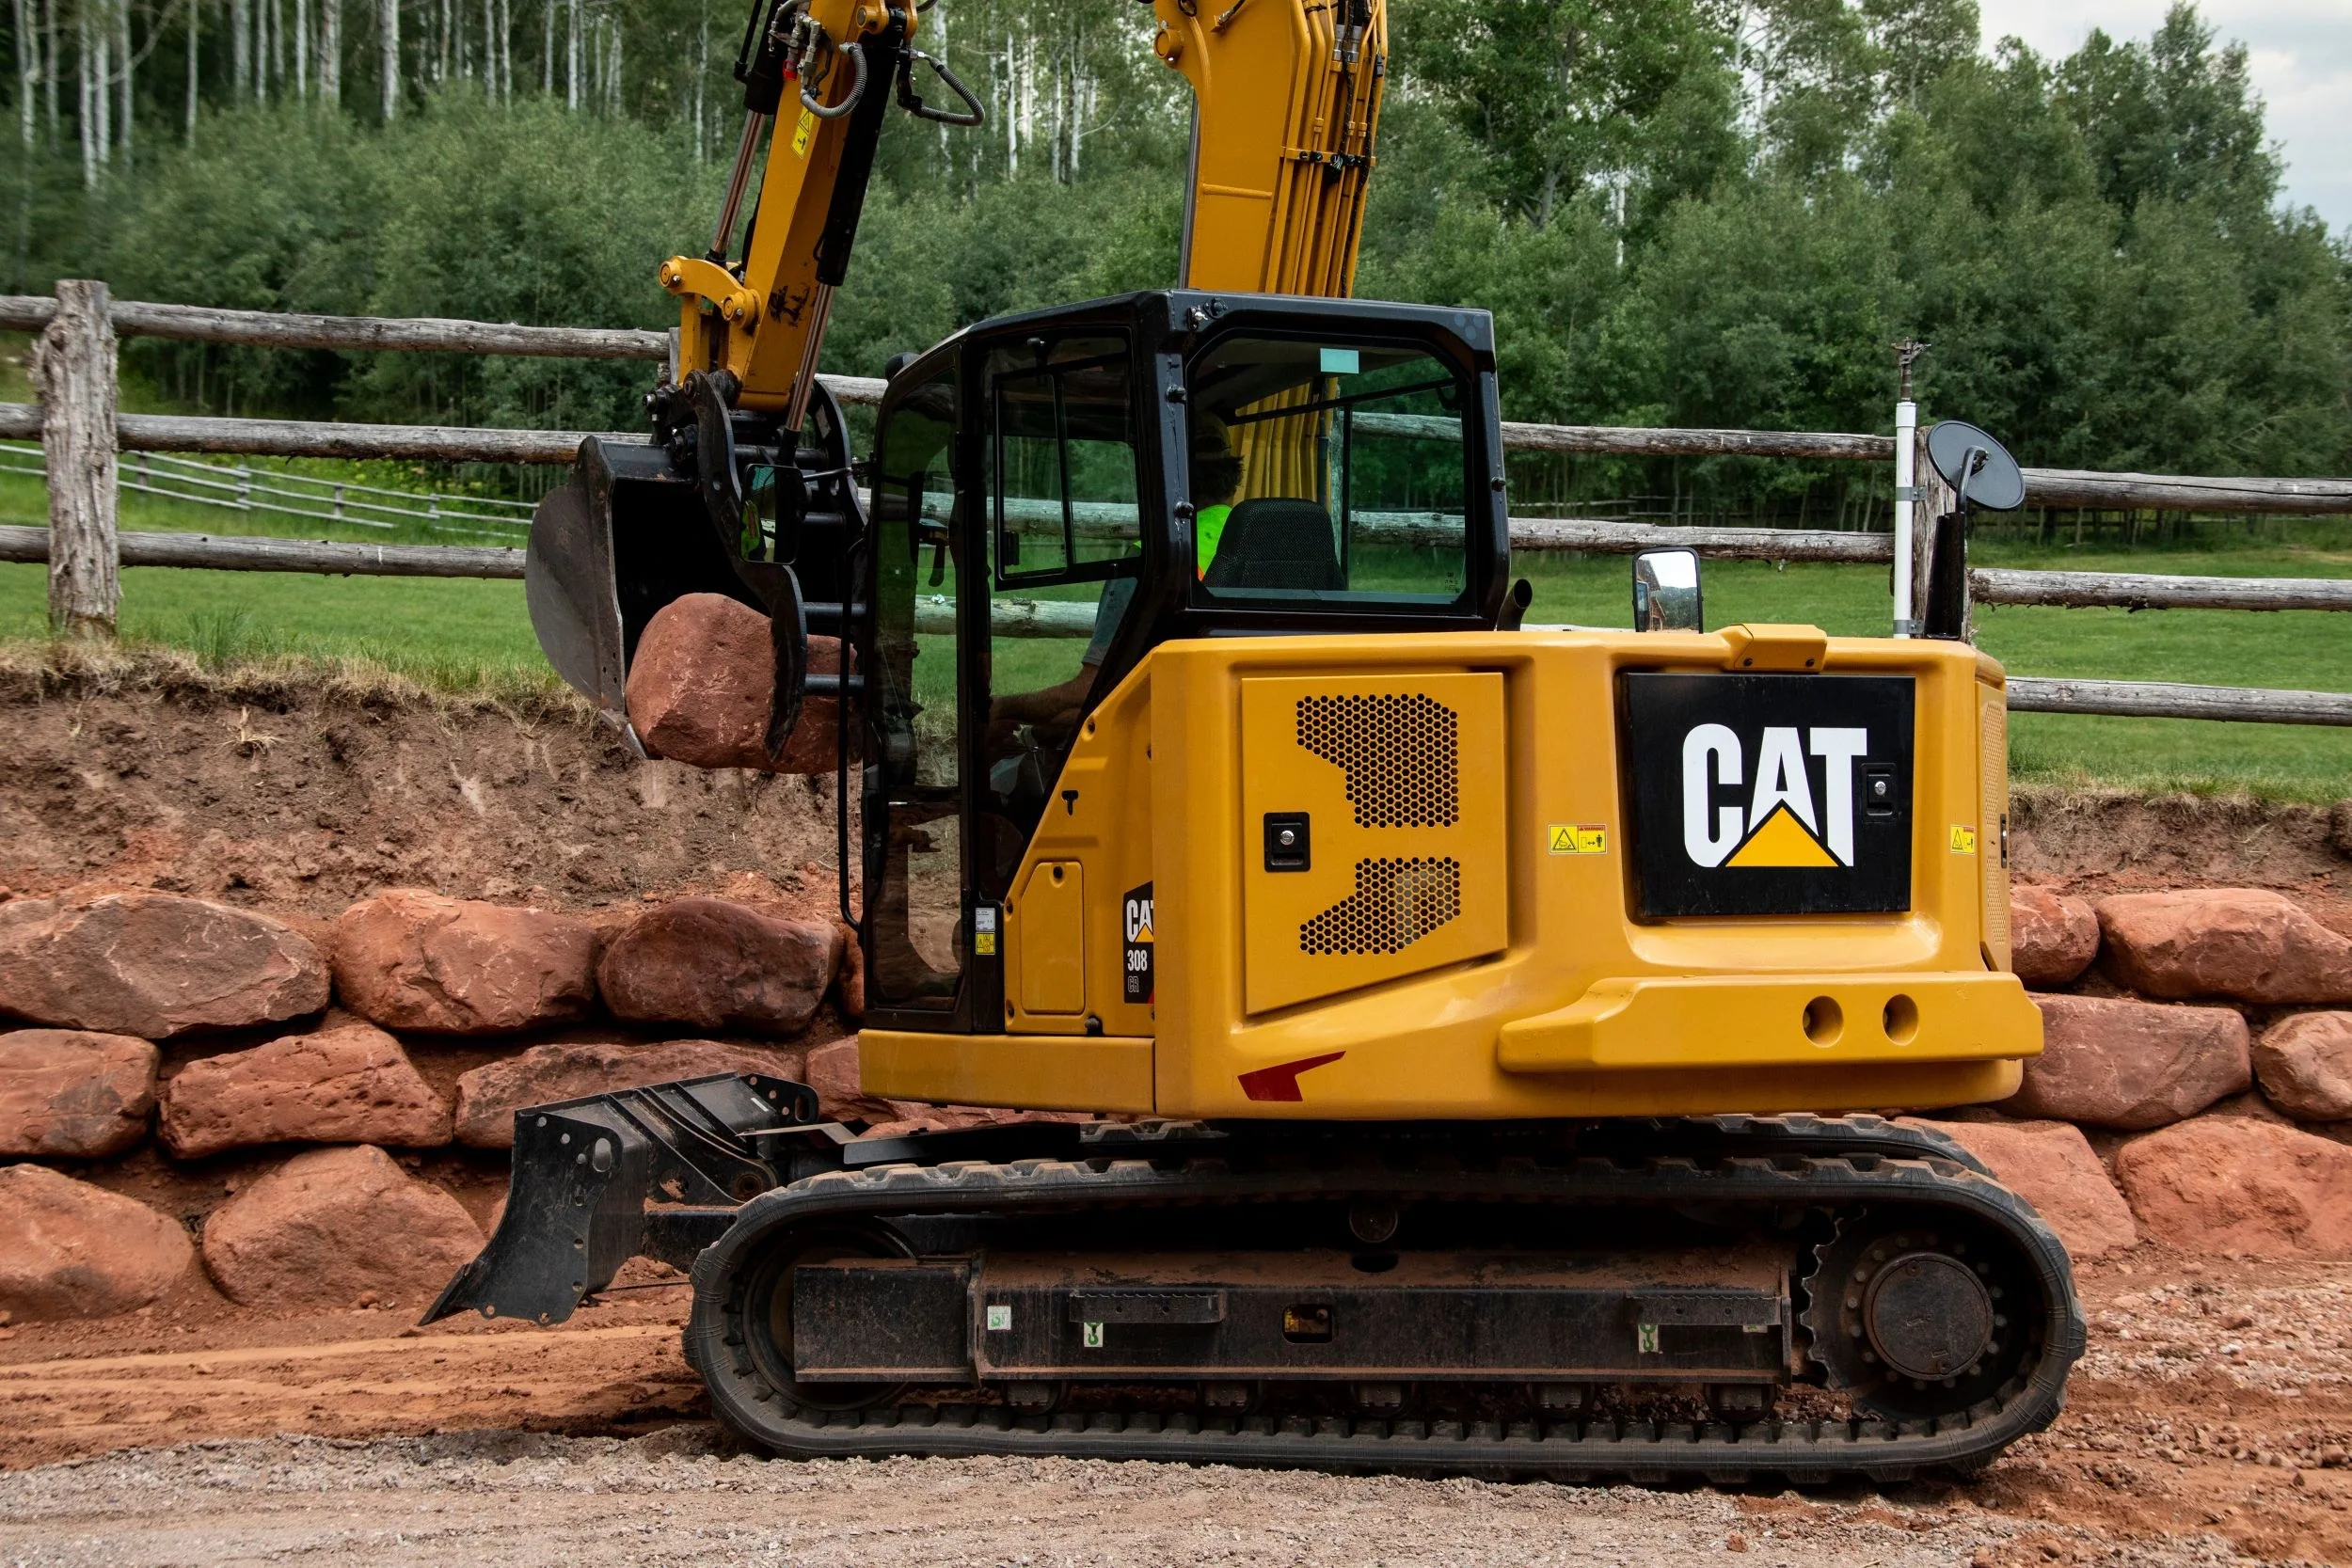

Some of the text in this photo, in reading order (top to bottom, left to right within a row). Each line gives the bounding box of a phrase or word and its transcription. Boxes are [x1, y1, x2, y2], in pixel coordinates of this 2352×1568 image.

[1682, 723, 1867, 868] CAT
[1126, 899, 1153, 942] CA
[1127, 949, 1148, 972] 308
